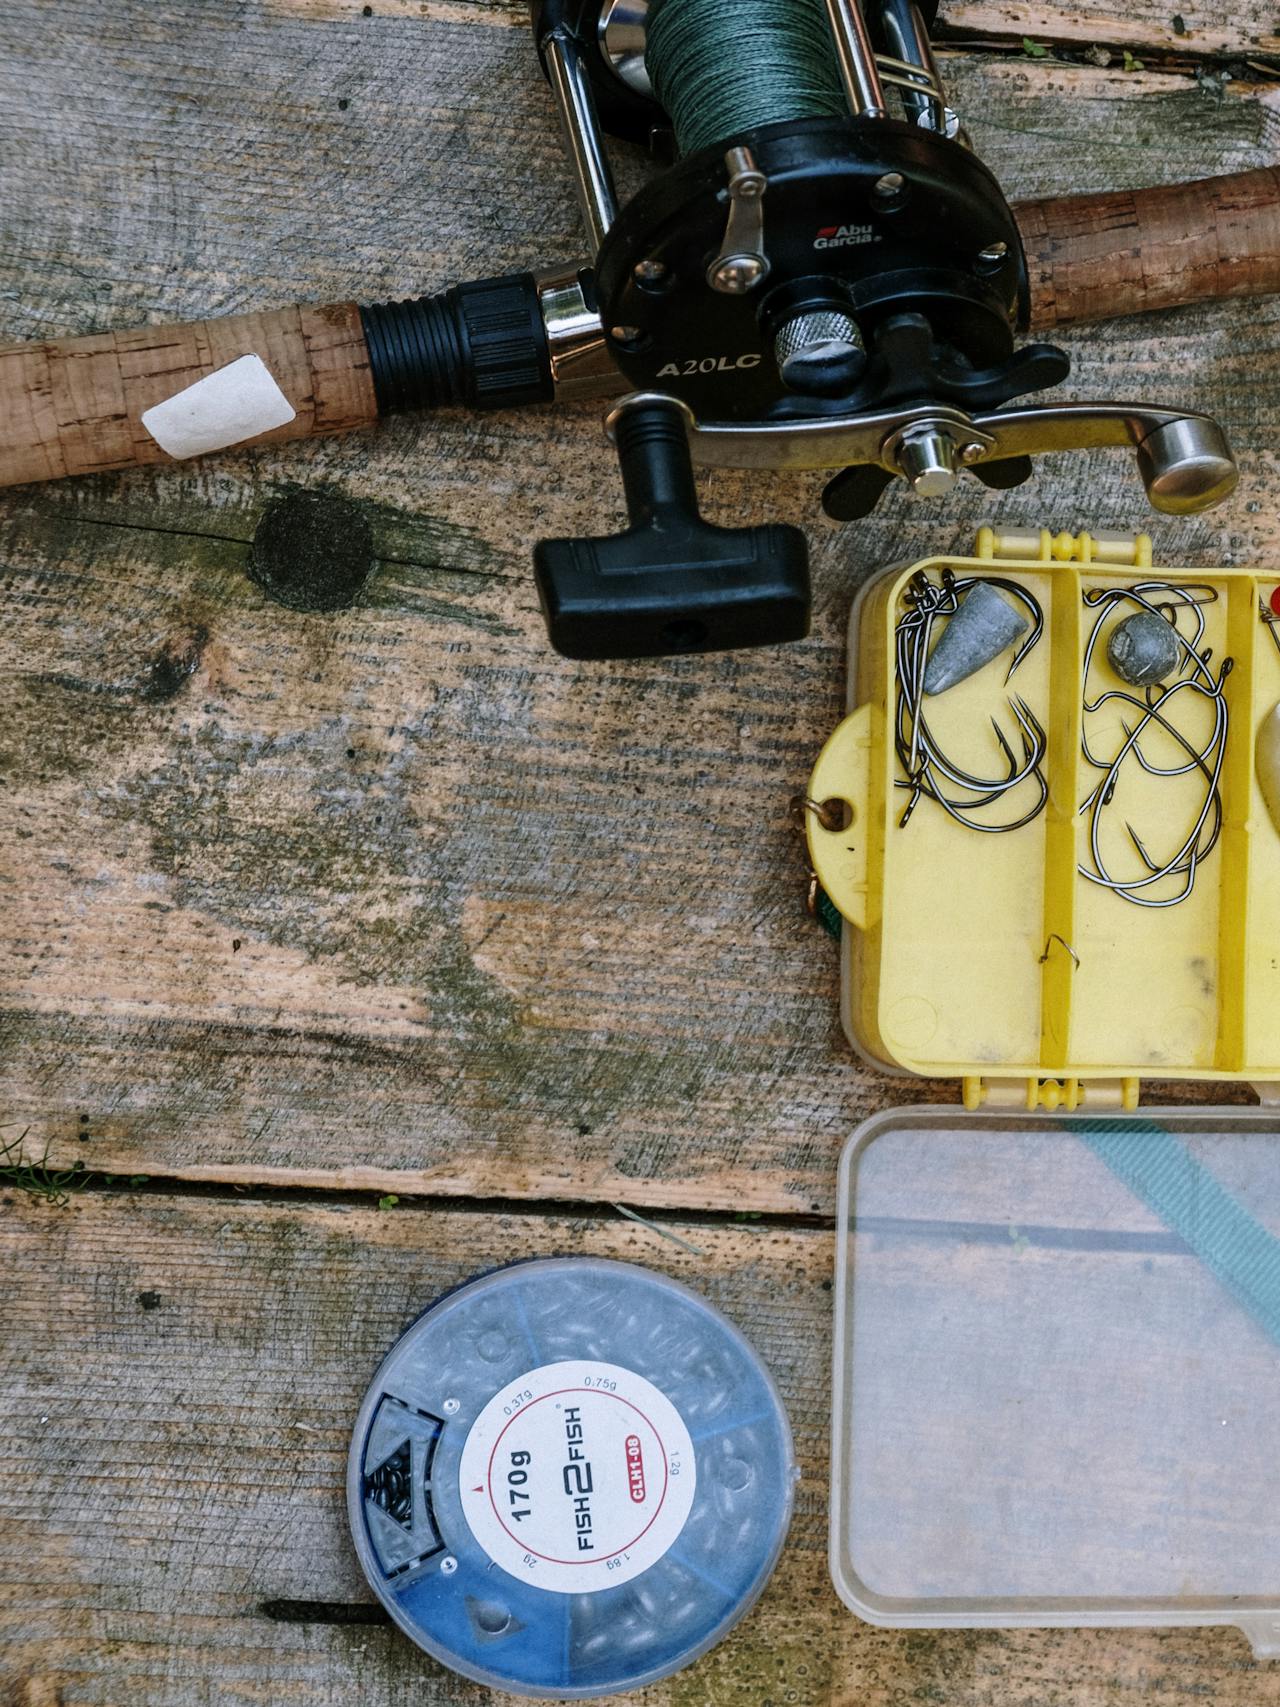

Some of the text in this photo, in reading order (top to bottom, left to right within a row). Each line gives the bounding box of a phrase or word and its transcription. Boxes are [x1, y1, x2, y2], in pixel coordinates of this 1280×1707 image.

[813, 234, 872, 249] Garcia
[836, 224, 873, 237] Abu
[656, 354, 761, 377] A20LC
[584, 1376, 617, 1391] 0.75g
[503, 1388, 534, 1416] 0.37g
[627, 1437, 645, 1499] CLH1-08
[669, 1450, 681, 1476] 1.2g
[507, 1449, 532, 1522] 170g
[563, 1406, 594, 1551] FISH2FISH
[522, 1554, 537, 1569] 2g
[606, 1552, 631, 1571] 1.8g
